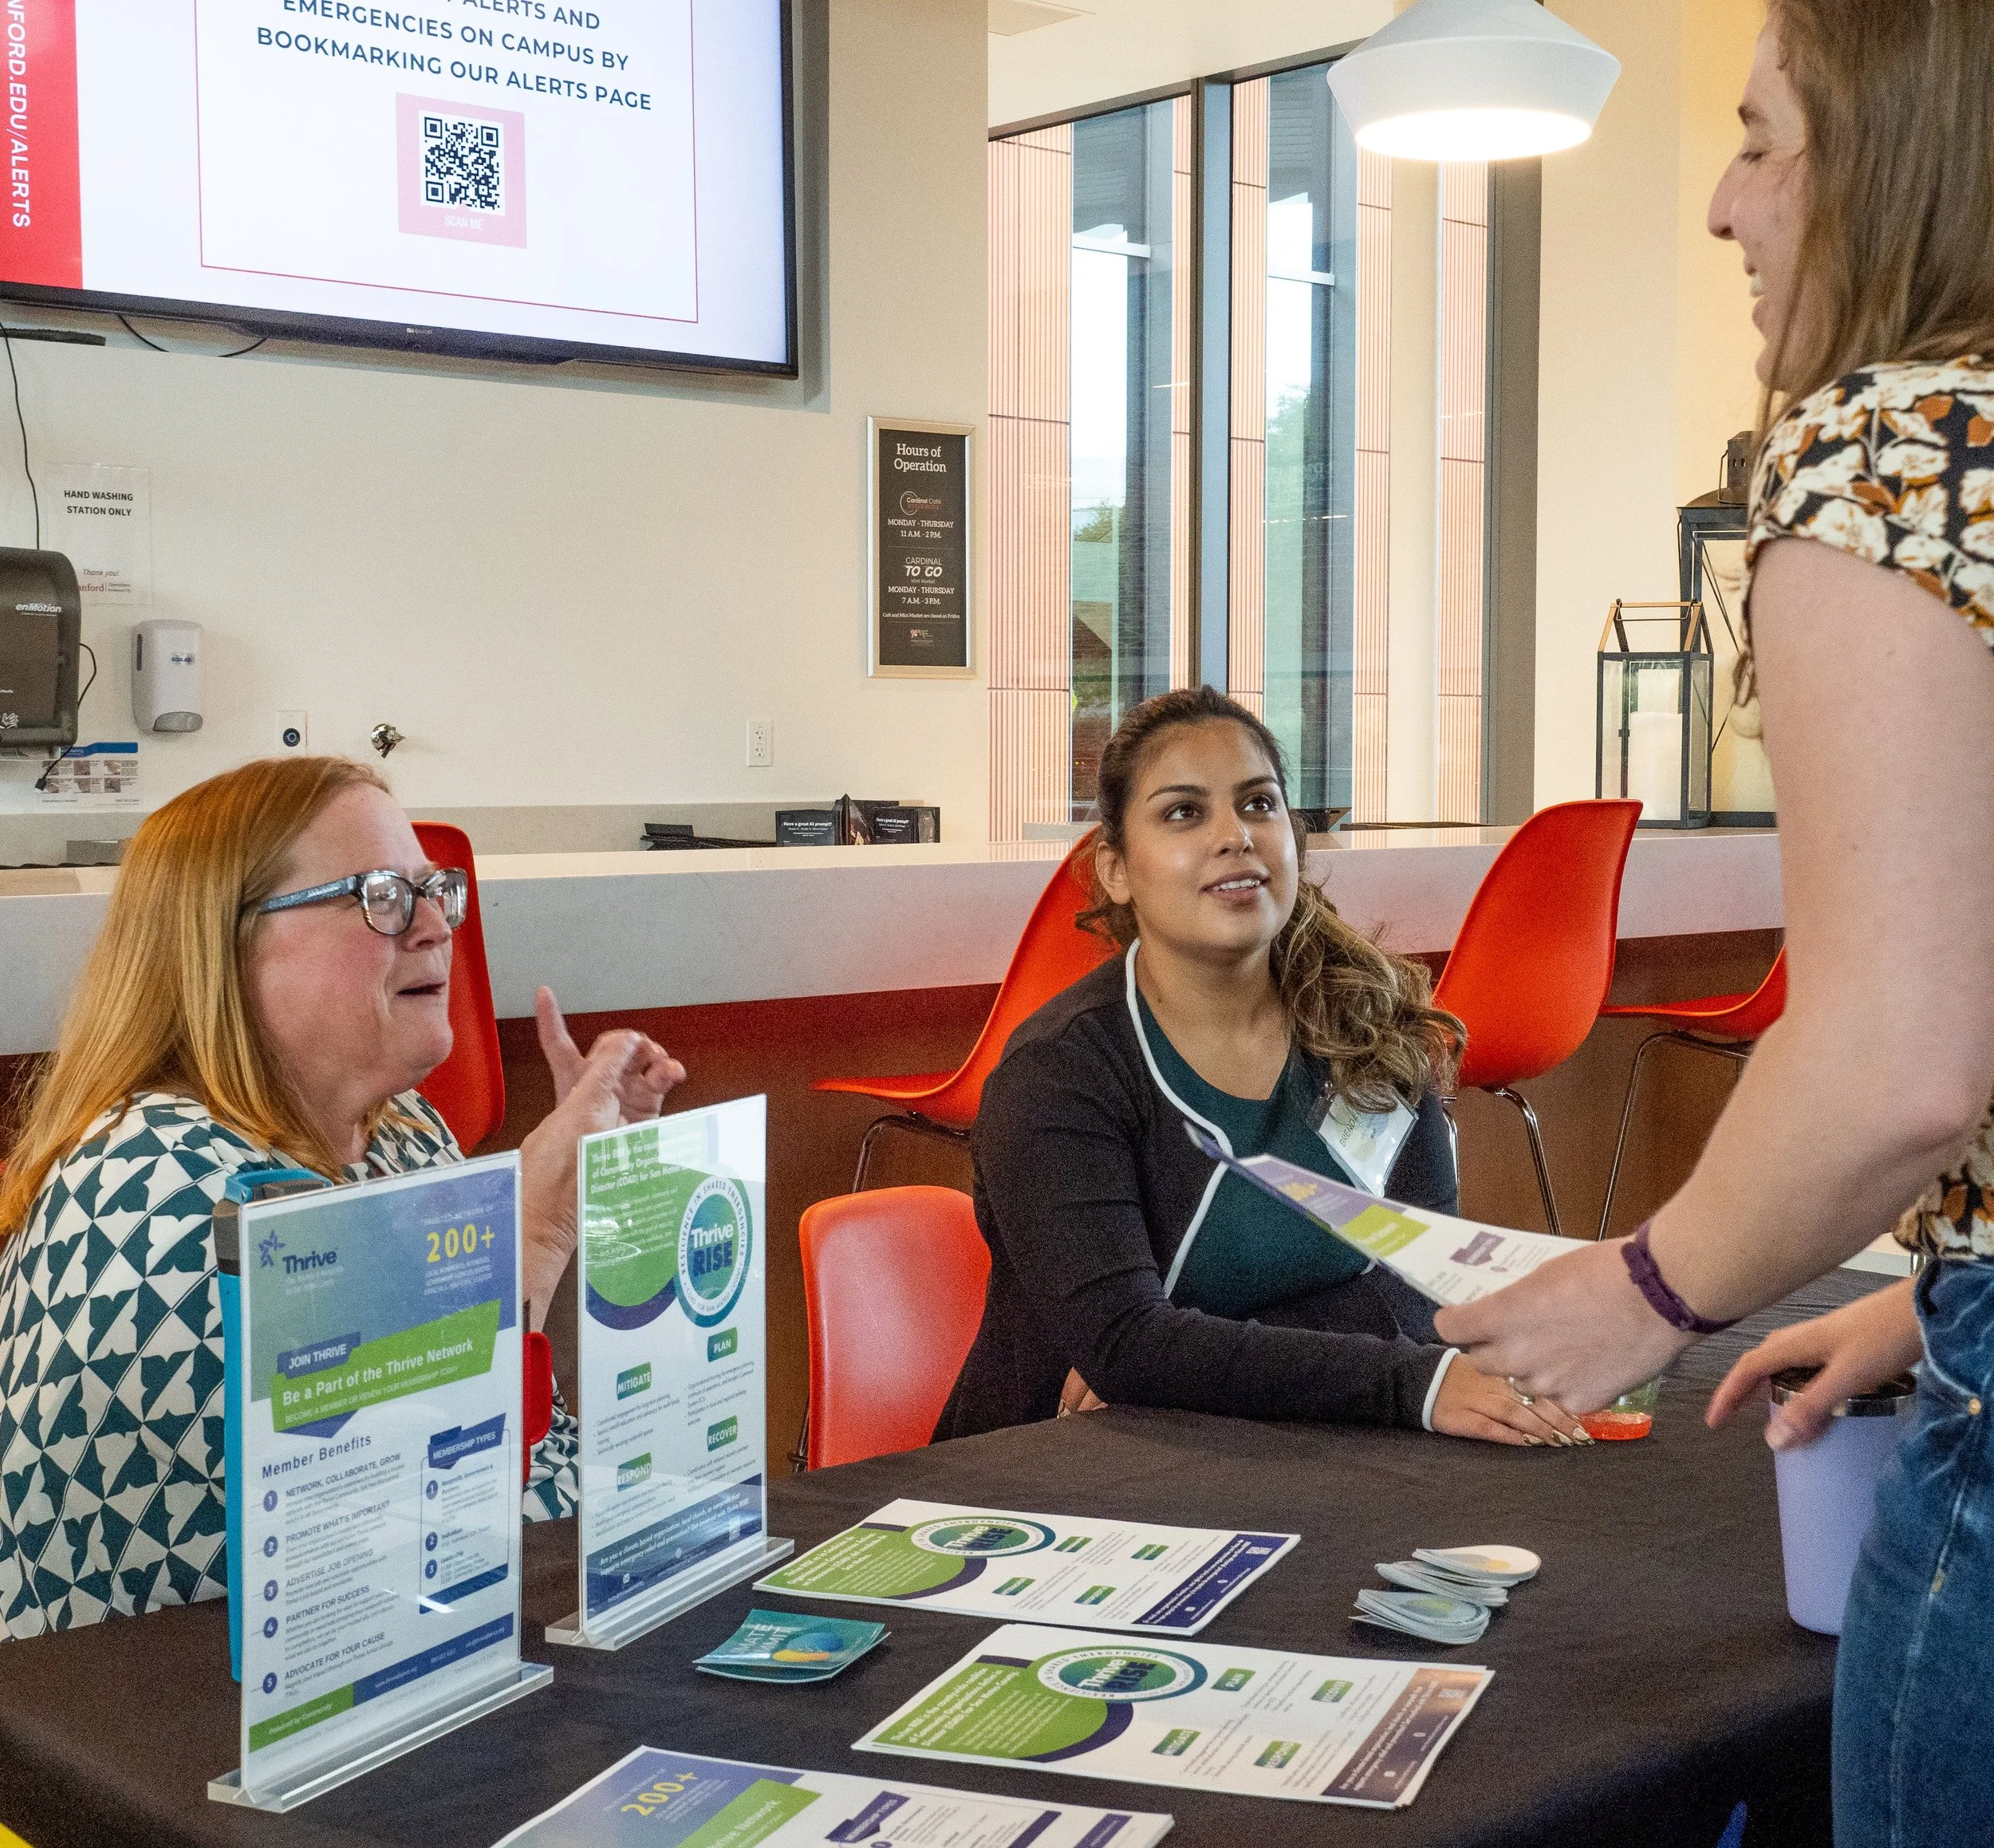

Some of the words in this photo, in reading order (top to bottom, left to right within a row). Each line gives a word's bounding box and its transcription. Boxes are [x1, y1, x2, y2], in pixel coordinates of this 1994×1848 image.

[553, 7, 600, 30] AND
[283, 0, 452, 39] EMERGENCIES
[461, 26, 492, 46] ON
[502, 33, 594, 64] CAMPUS
[602, 51, 629, 70] BY
[258, 27, 441, 74] BOOKMARKING
[451, 61, 498, 84] OUR
[506, 71, 588, 100] ALERTS
[596, 85, 651, 110] PAGE
[445, 215, 467, 228] SCAN
[471, 219, 483, 230] ME
[897, 443, 928, 456] Hours
[931, 447, 941, 457] of
[894, 458, 947, 472] Operation
[93, 492, 133, 501] WASHING
[904, 565, 921, 577] TO
[925, 566, 943, 577] GO
[16, 603, 61, 613] enMotion
[680, 1208, 694, 1275] RESILIENCE
[694, 1192, 702, 1205] IN
[703, 1180, 727, 1195] SHARED
[727, 1187, 745, 1255] EMERGENCIES
[692, 1223, 734, 1249] Thrive
[427, 1224, 495, 1263] 200+
[282, 1250, 337, 1275] Thrive
[693, 1240, 733, 1278] RISE
[289, 1354, 311, 1369] JOIN
[313, 1344, 347, 1362] THRIVE
[714, 1338, 731, 1354] PLAN
[283, 1391, 300, 1407] Be
[305, 1388, 313, 1401] a
[316, 1377, 343, 1397] Part
[346, 1370, 360, 1387] of
[363, 1366, 382, 1382] the
[386, 1354, 424, 1375] Thrive
[427, 1338, 474, 1363] Network
[617, 1371, 652, 1395] MITIGATE
[433, 1439, 475, 1460] MEMBERSHIP
[476, 1431, 496, 1444] TYPES
[707, 1423, 738, 1447] RECOVER
[262, 1452, 313, 1480] Member
[319, 1434, 372, 1461] Benefits
[379, 1453, 401, 1467] GROW
[617, 1461, 652, 1487] RESPOND
[286, 1524, 321, 1543] PROMOTE
[323, 1515, 350, 1531] WHAT'S
[351, 1499, 391, 1520] IMPORTANT
[286, 1566, 325, 1587] ADVERTISE
[327, 1561, 341, 1573] JOB
[343, 1548, 373, 1566] OPENING
[286, 1606, 320, 1624] PARTNER
[321, 1598, 337, 1610] FOR
[337, 1585, 370, 1604] SUCCESS
[285, 1659, 324, 1681] ADVOCATE
[325, 1650, 340, 1664] FOR
[341, 1643, 361, 1656] YOUR
[361, 1632, 385, 1648] CAUSE
[1077, 1659, 1127, 1688] Thrive
[1103, 1661, 1157, 1692] RISE
[620, 1771, 699, 1817] 200+
